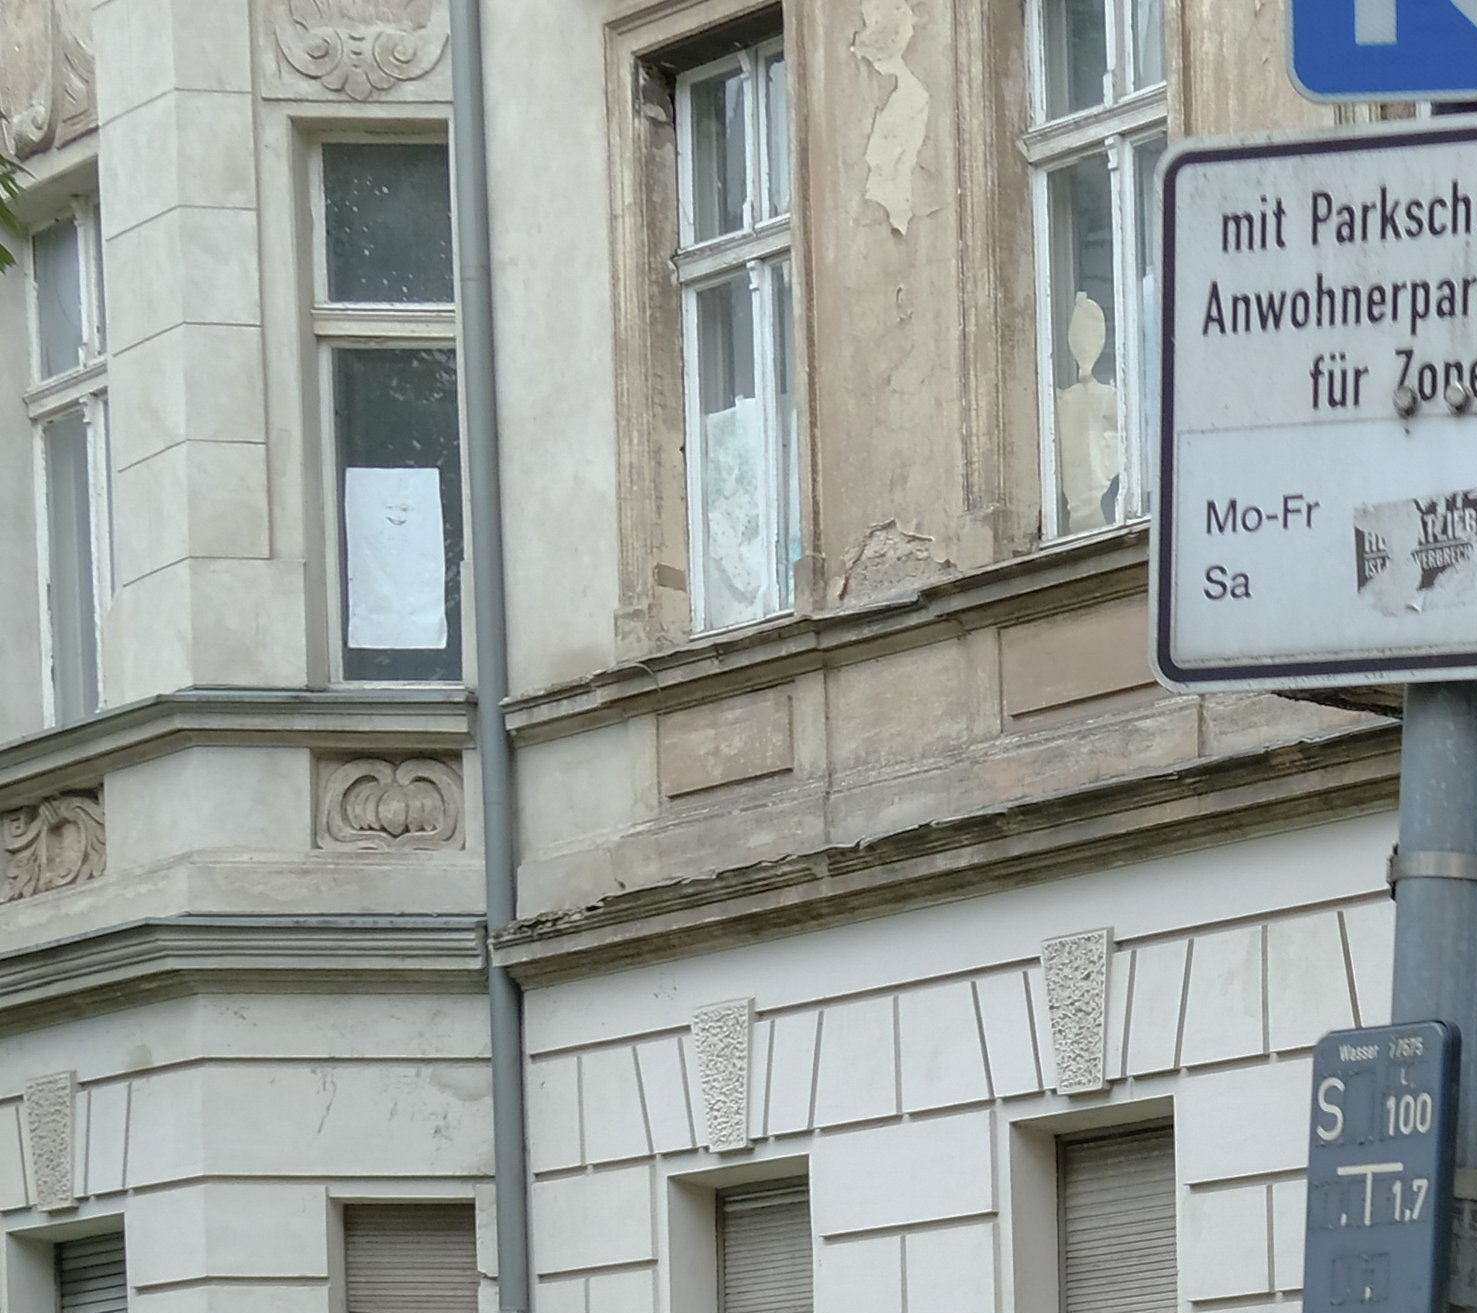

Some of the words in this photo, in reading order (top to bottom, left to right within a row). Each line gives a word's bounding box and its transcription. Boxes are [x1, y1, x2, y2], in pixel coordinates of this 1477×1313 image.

[1221, 195, 1286, 254] mit
[1309, 352, 1369, 409] für
[1205, 495, 1320, 535] Mo-Fr
[1203, 565, 1251, 600] Sa
[1316, 1077, 1346, 1142] S
[1385, 1092, 1433, 1137] 100
